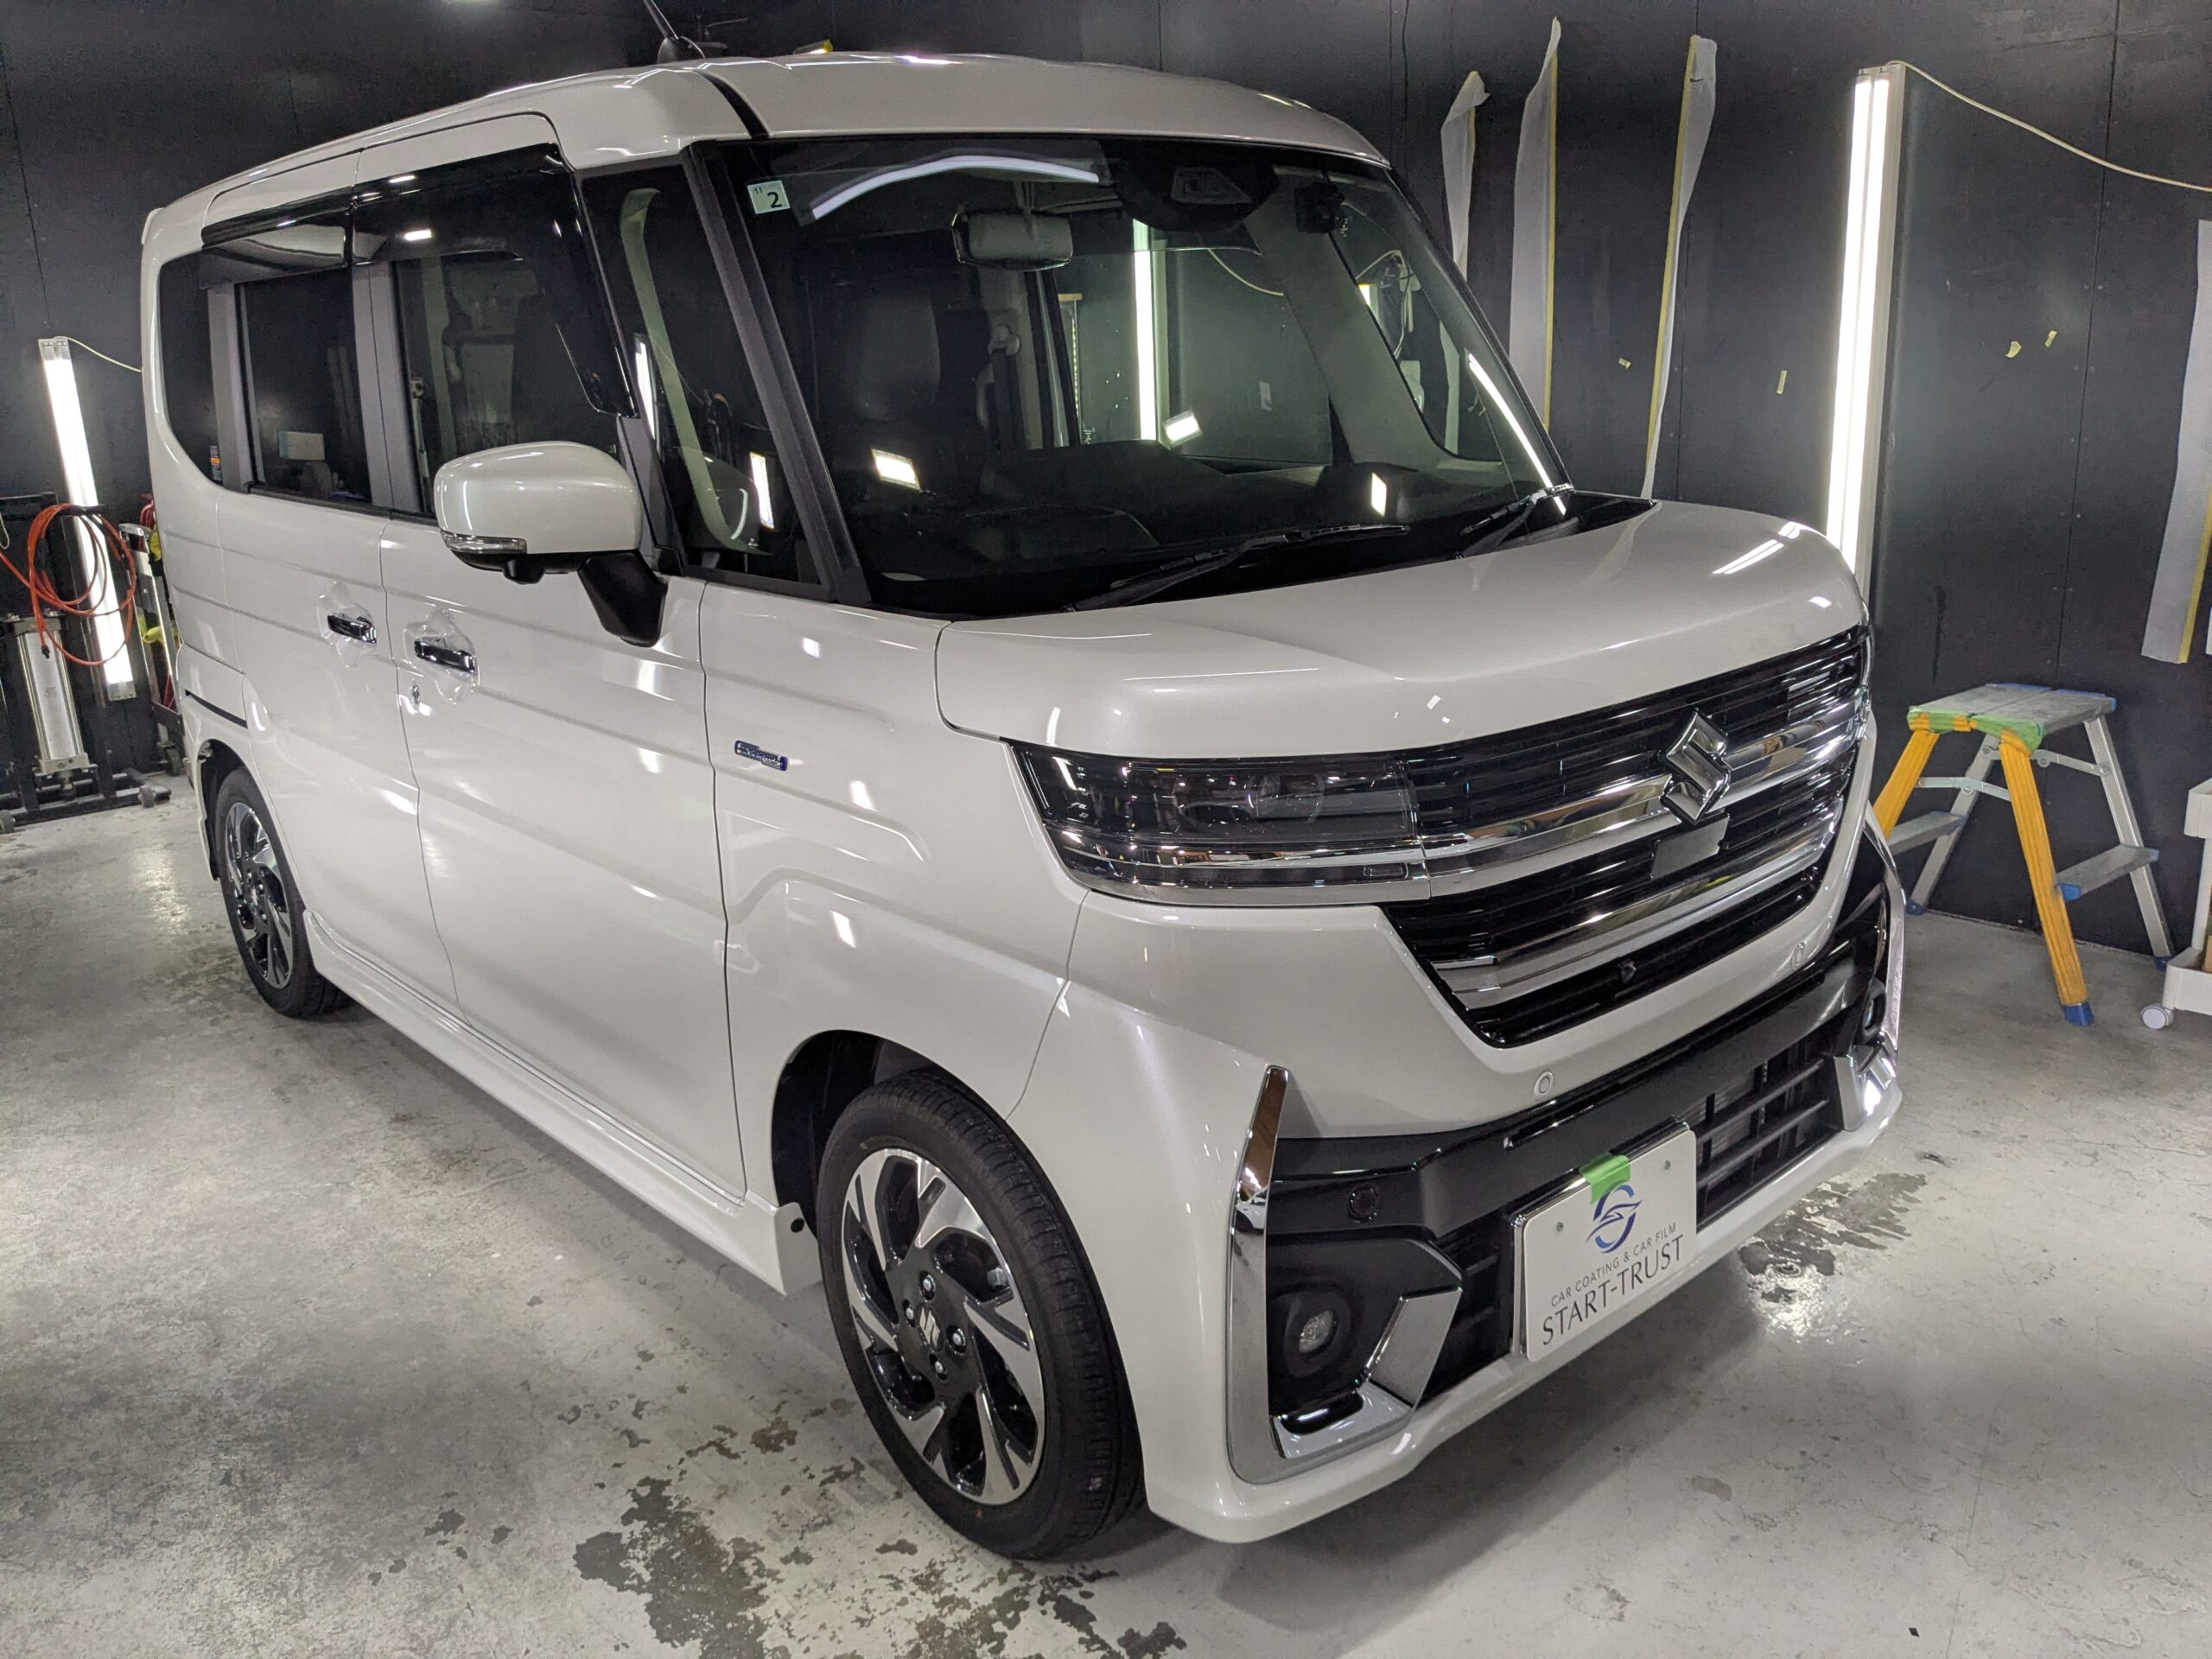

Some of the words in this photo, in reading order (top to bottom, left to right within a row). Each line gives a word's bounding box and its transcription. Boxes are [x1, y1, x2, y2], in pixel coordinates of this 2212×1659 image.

[766, 191, 783, 208] 2
[1542, 1234, 1684, 1345] START-TRUST
[1551, 1287, 1572, 1306] CAR
[1575, 1257, 1619, 1292] COATING
[1623, 1251, 1630, 1262] &
[1633, 1237, 1652, 1255] CAR
[1656, 1222, 1676, 1244] FILM
